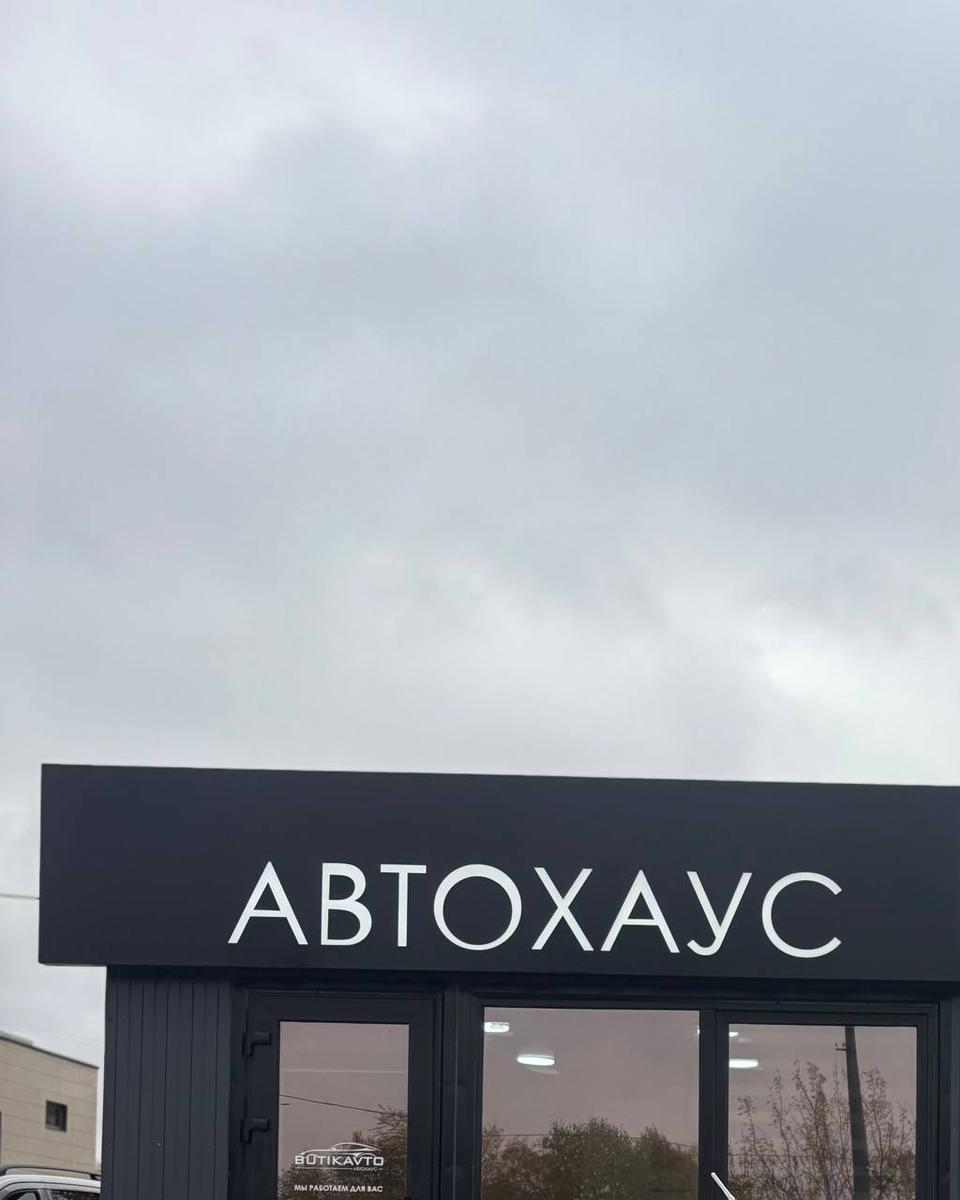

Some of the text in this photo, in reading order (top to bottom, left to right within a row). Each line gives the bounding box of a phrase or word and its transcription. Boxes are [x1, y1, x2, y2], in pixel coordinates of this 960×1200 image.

[228, 861, 842, 958] АВТОХАУС
[295, 1155, 384, 1166] BUTIKAVTO
[309, 1184, 349, 1192] РАБОТАЕМ
[350, 1185, 366, 1193] ДЛЯ
[367, 1185, 384, 1193] ВАС
